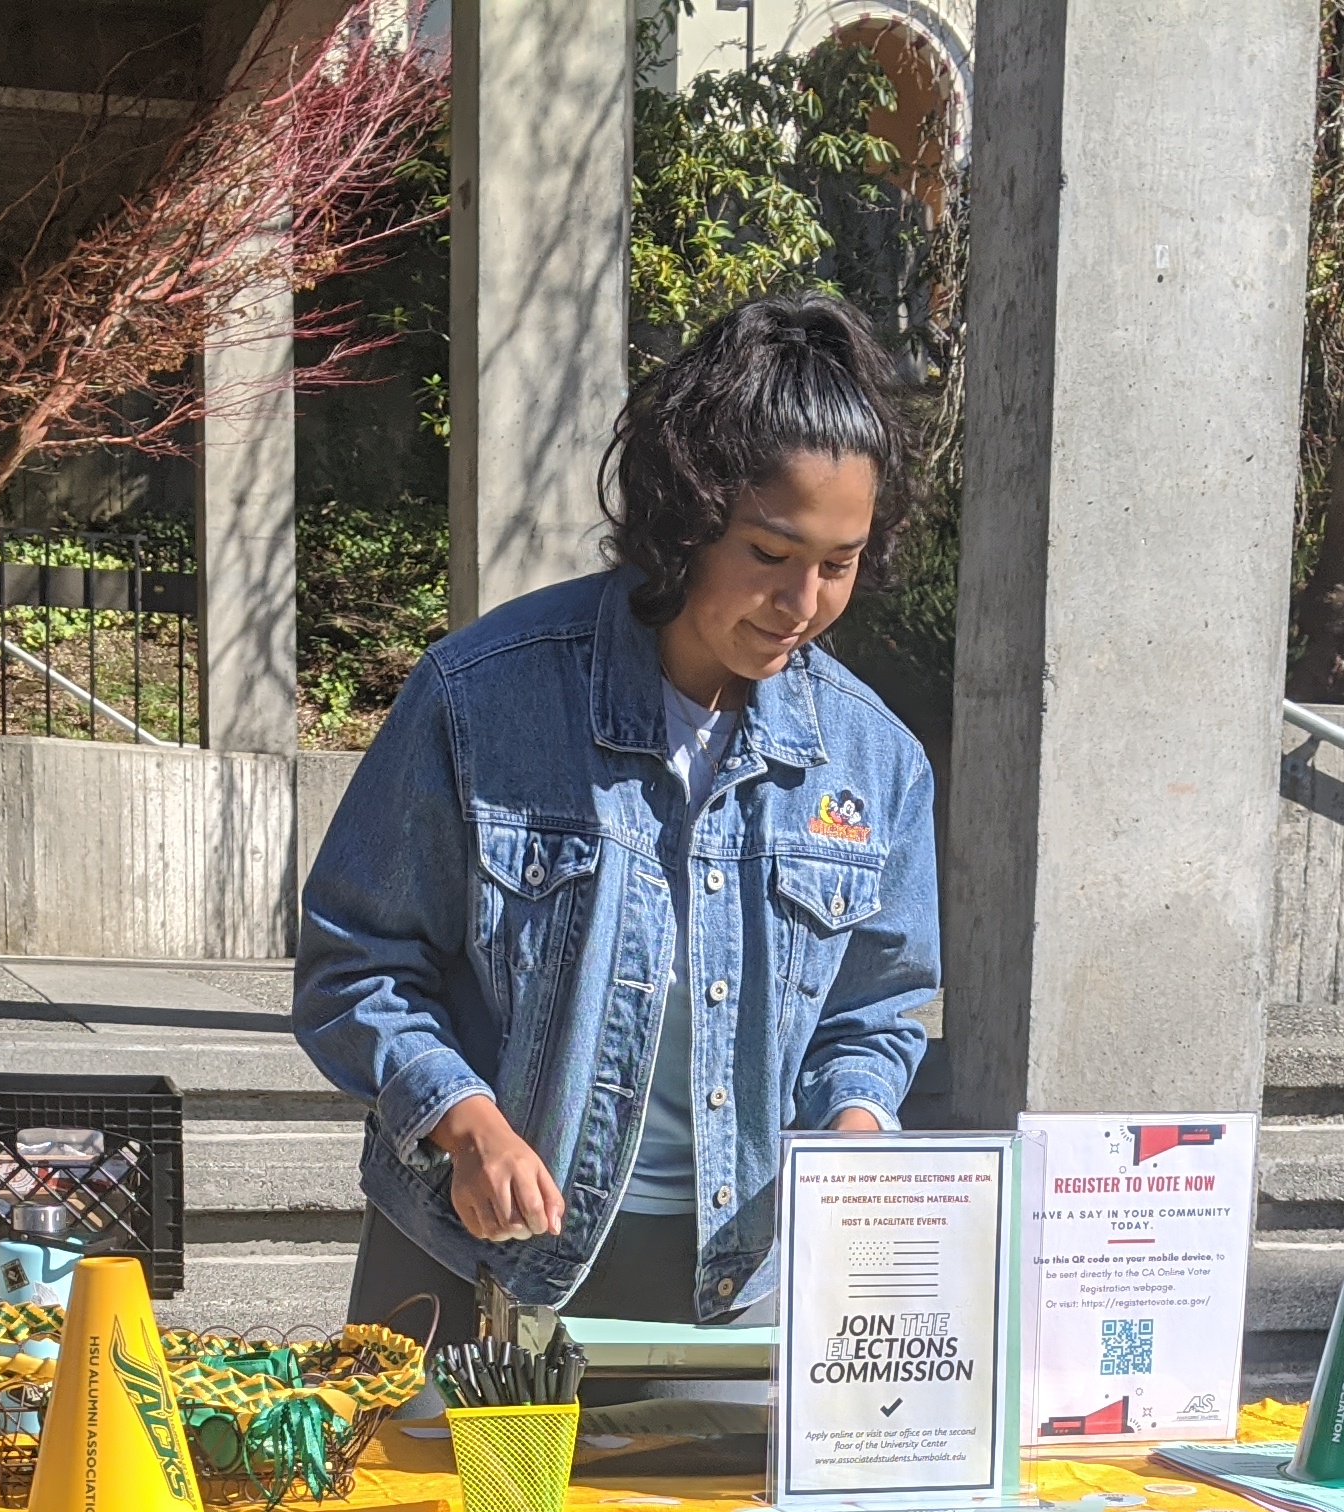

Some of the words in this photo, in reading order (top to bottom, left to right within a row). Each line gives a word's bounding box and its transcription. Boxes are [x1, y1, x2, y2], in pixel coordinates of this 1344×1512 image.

[799, 1174, 820, 1183] HAVE
[823, 1174, 829, 1183] A
[830, 1174, 845, 1183] SAY
[848, 1174, 856, 1183] IN
[858, 1174, 877, 1183] HOW
[879, 1174, 912, 1183] CAMPUS
[914, 1174, 955, 1183] ELECTIONS
[957, 1174, 973, 1183] ARE
[1054, 1177, 1120, 1194] REGISTER
[1125, 1176, 1142, 1193] TO
[1147, 1176, 1180, 1192] VOTE
[1184, 1175, 1215, 1192] NOW
[821, 1195, 840, 1204] HELP
[842, 1195, 881, 1204] GENERATE
[884, 1195, 924, 1204] ELECTIONS
[1032, 1210, 1062, 1220] HAVE
[1066, 1210, 1075, 1220] A
[1079, 1210, 1103, 1219] SAY
[1107, 1209, 1119, 1219] IN
[1123, 1209, 1154, 1218] YOUR
[1158, 1207, 1231, 1217] COMMUNITY
[842, 1217, 862, 1226] HOST
[873, 1217, 914, 1226] FACILITATE
[917, 1217, 948, 1226] EVENTS.
[1111, 1221, 1154, 1230] TODAY.
[1033, 1256, 1050, 1265] Use
[1052, 1255, 1069, 1264] this
[1072, 1255, 1085, 1264] QR
[1087, 1255, 1110, 1263] code
[1125, 1256, 1146, 1265] your
[1148, 1253, 1179, 1262] mobile
[1216, 1253, 1225, 1261] to
[1046, 1270, 1057, 1278] be
[1059, 1270, 1078, 1278] sent
[1080, 1269, 1112, 1280] directly
[1125, 1269, 1139, 1277] the
[1141, 1268, 1155, 1277] CA
[1157, 1268, 1185, 1276] Online
[1187, 1267, 1212, 1276] Voter
[1080, 1285, 1131, 1295] Registration
[1133, 1284, 1176, 1294] webpage.
[1045, 1300, 1057, 1309] Or
[1059, 1300, 1078, 1308] visit:
[836, 1314, 895, 1337] JOIN
[900, 1313, 950, 1336] THE
[89, 1336, 100, 1366] HSU
[825, 1336, 958, 1361] ELECTIONS
[810, 1359, 974, 1384] COMMISSION
[87, 1371, 100, 1427] ALUMNI
[805, 1430, 828, 1441] Apply
[830, 1430, 854, 1439] online
[866, 1429, 882, 1438] visit
[899, 1428, 920, 1439] office
[921, 1429, 933, 1437] on
[934, 1428, 947, 1436] the
[949, 1427, 976, 1436] second
[834, 1440, 853, 1452] floor
[855, 1440, 865, 1451] of
[865, 1440, 878, 1449] the
[880, 1439, 918, 1450] University
[920, 1439, 948, 1448] Center
